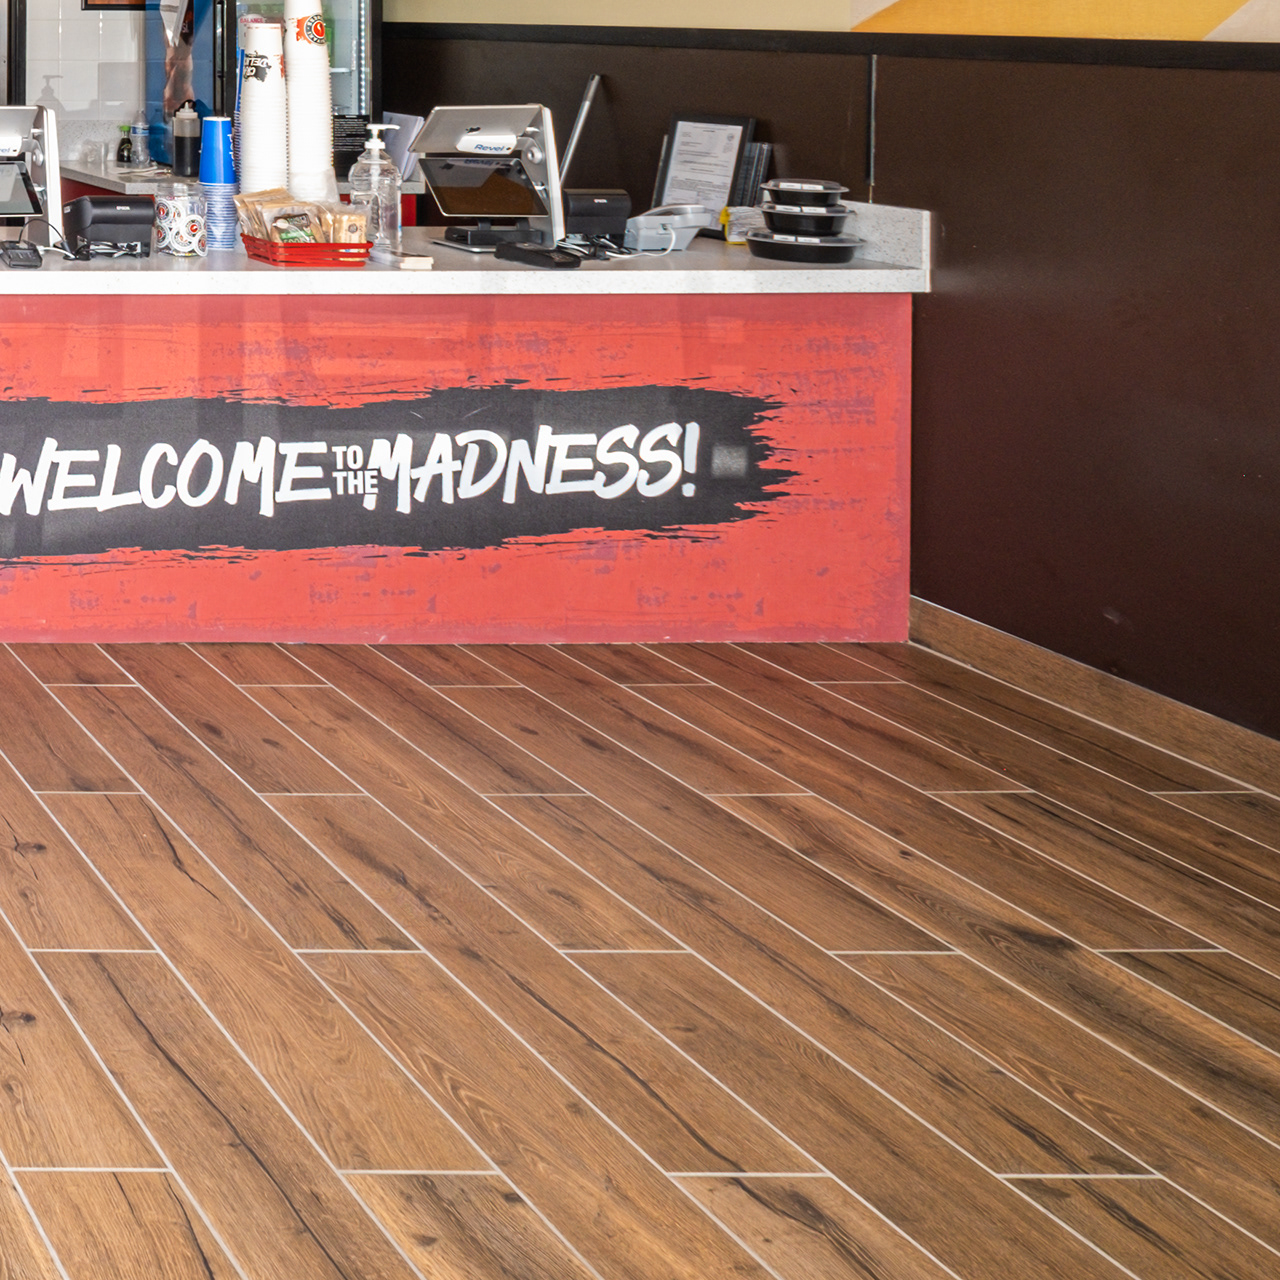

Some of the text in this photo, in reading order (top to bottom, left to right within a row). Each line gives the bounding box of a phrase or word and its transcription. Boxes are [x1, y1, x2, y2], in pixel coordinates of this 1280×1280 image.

[475, 143, 505, 152] Revel
[333, 447, 362, 470] TO
[363, 423, 700, 515] MADNESS!
[332, 470, 379, 496] THE
